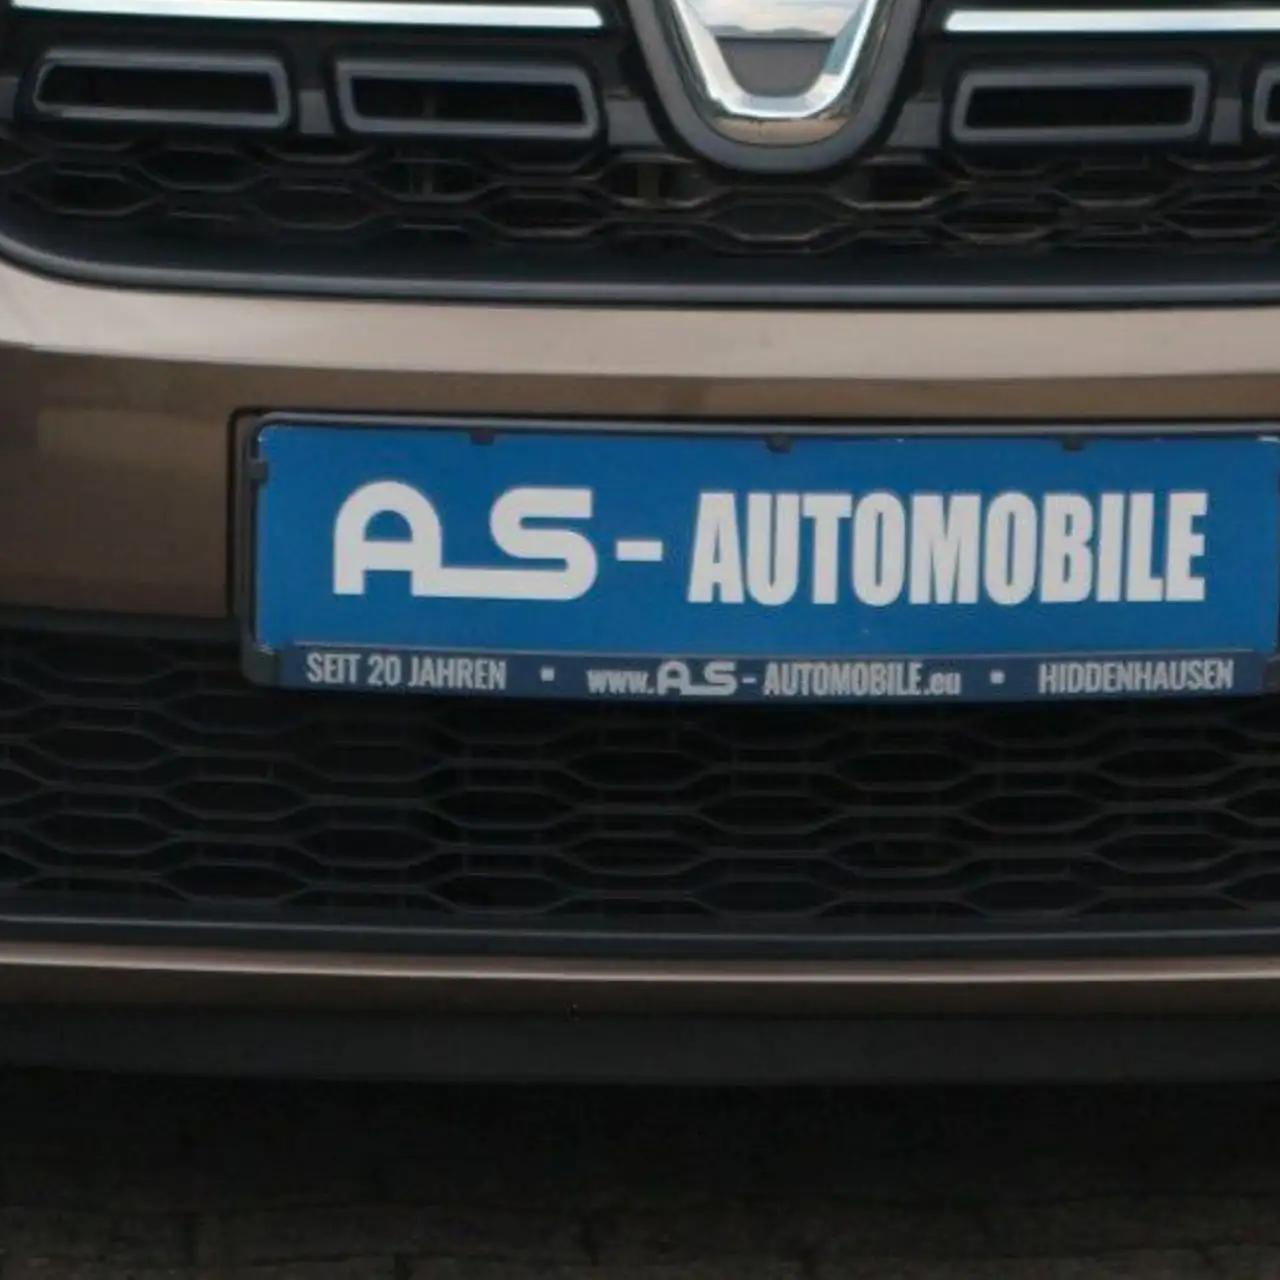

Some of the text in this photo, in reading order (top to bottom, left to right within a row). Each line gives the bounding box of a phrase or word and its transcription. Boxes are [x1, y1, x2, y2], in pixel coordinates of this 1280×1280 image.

[686, 491, 1210, 606] AUTOMOBILE
[306, 651, 361, 685] SEIT
[367, 654, 399, 687] 20
[408, 654, 508, 692] JAHREN
[1038, 659, 1235, 694] HIDDENHAUSEN
